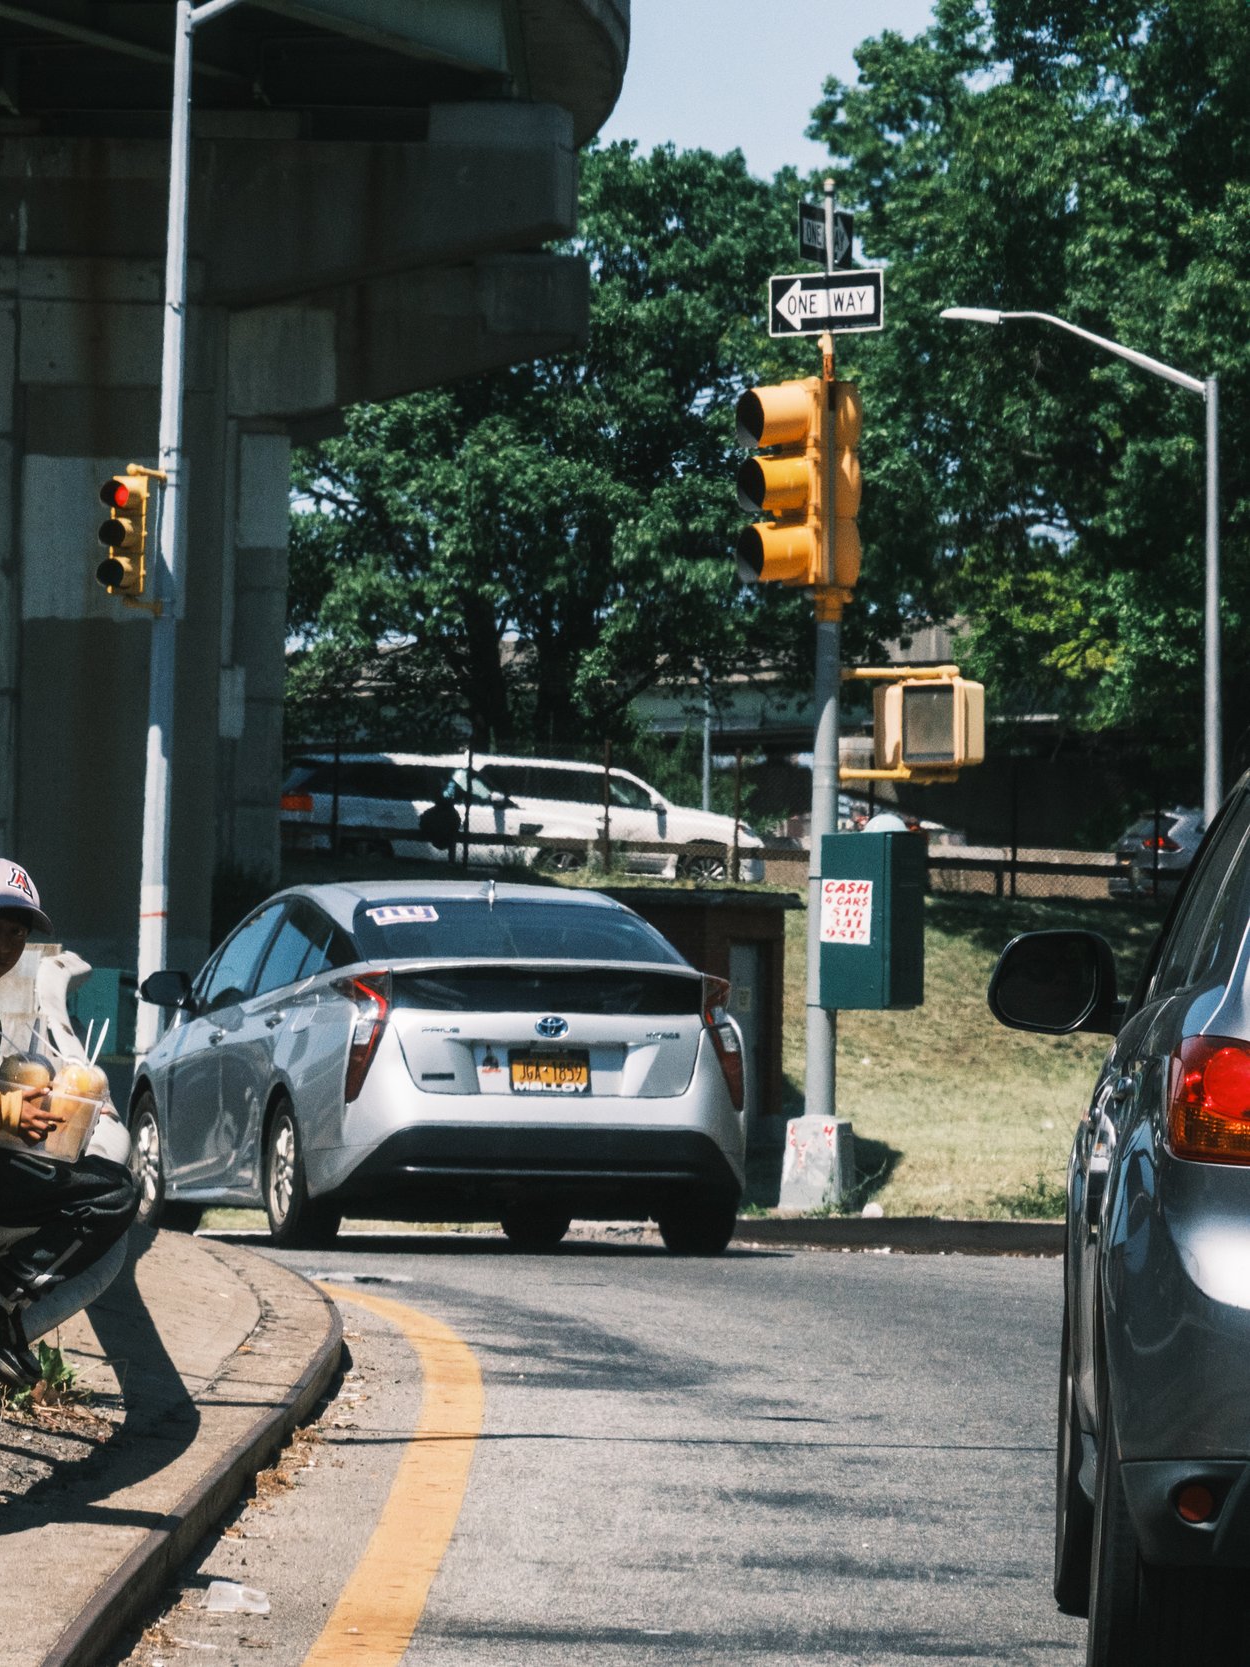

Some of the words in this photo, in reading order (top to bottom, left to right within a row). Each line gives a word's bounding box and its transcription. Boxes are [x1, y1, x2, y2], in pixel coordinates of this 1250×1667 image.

[806, 221, 823, 246] ONE
[787, 294, 818, 316] ONE
[833, 291, 867, 313] WAY
[7, 867, 34, 899] A
[824, 881, 870, 894] CASH
[837, 896, 869, 907] CARS
